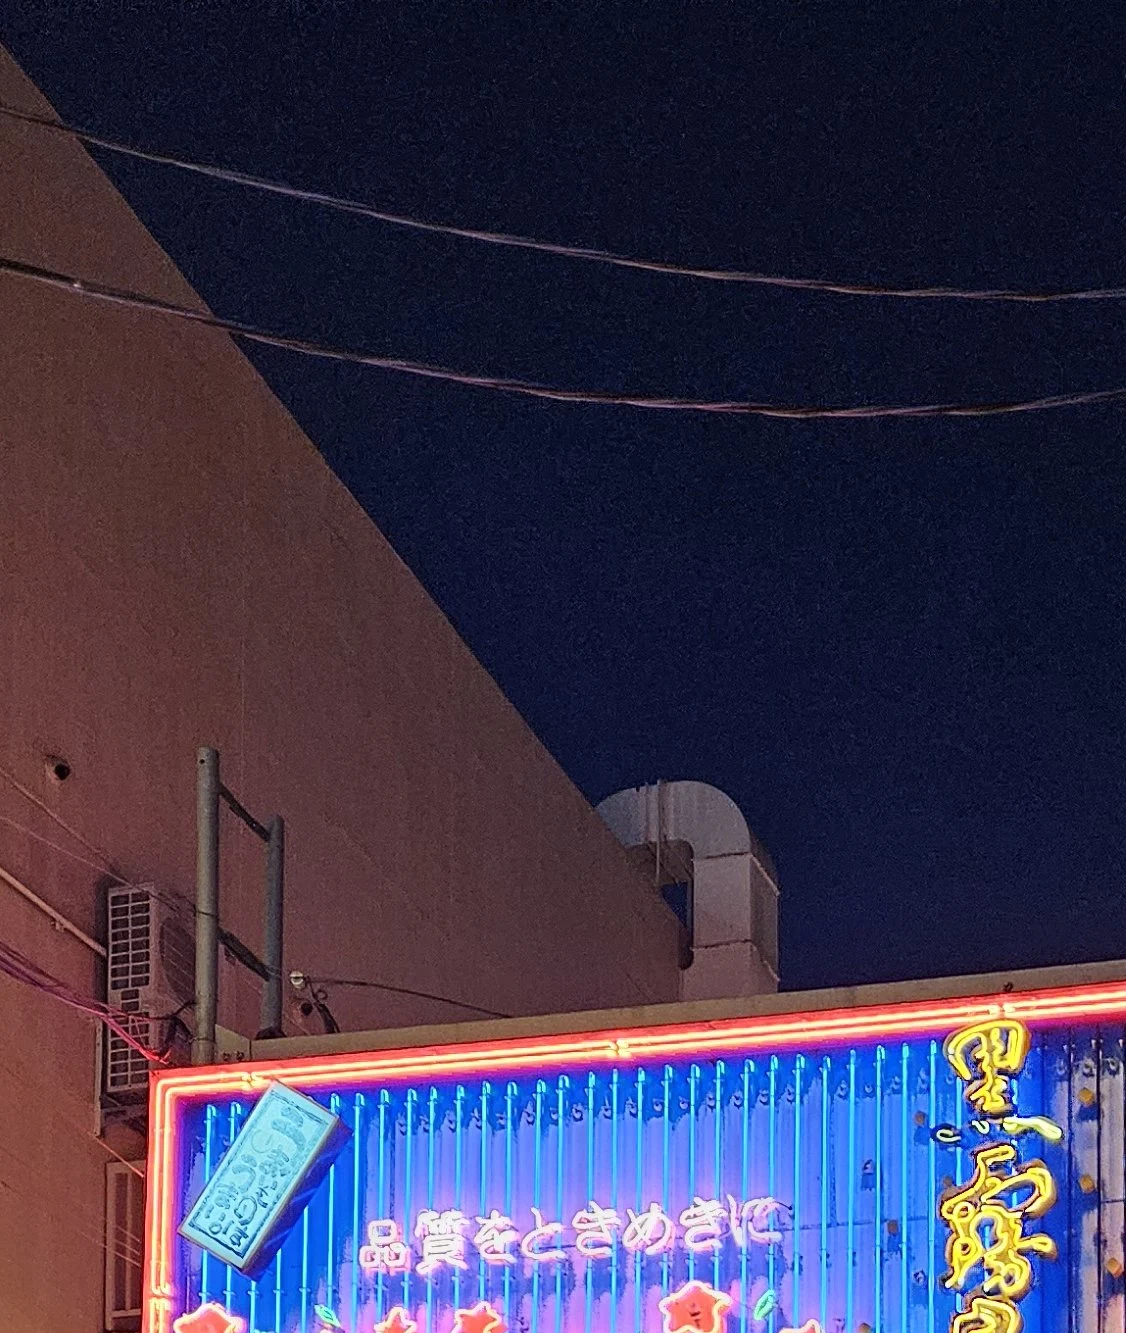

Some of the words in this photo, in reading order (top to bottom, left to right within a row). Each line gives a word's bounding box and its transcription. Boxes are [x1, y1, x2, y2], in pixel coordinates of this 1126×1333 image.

[360, 1194, 784, 1273] 品質をときめきに
